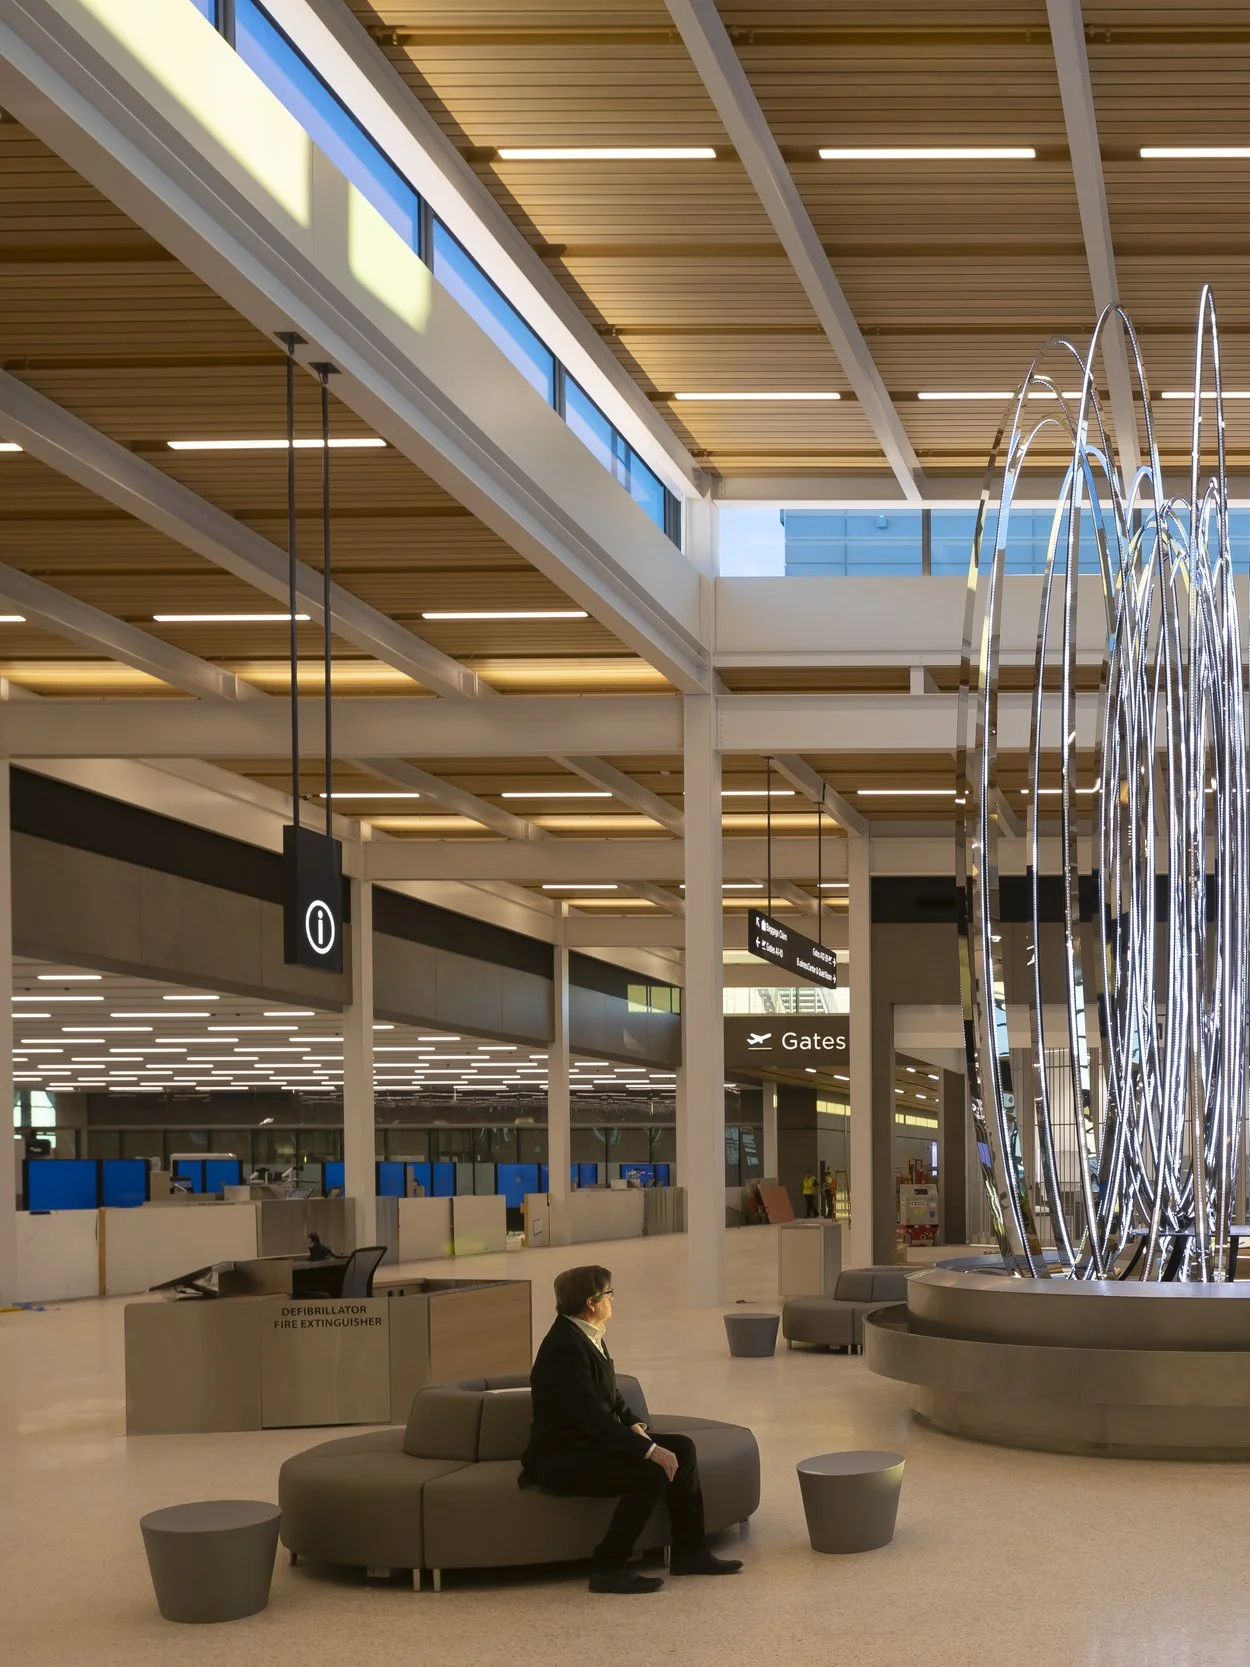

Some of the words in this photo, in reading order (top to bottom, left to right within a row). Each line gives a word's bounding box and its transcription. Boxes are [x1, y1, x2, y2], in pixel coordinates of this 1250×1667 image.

[781, 1032, 847, 1050] Gates
[281, 1305, 367, 1317] DEFIBRILLATOR
[273, 1320, 298, 1329] FIRE
[300, 1317, 383, 1328] EXTINGUISHER
